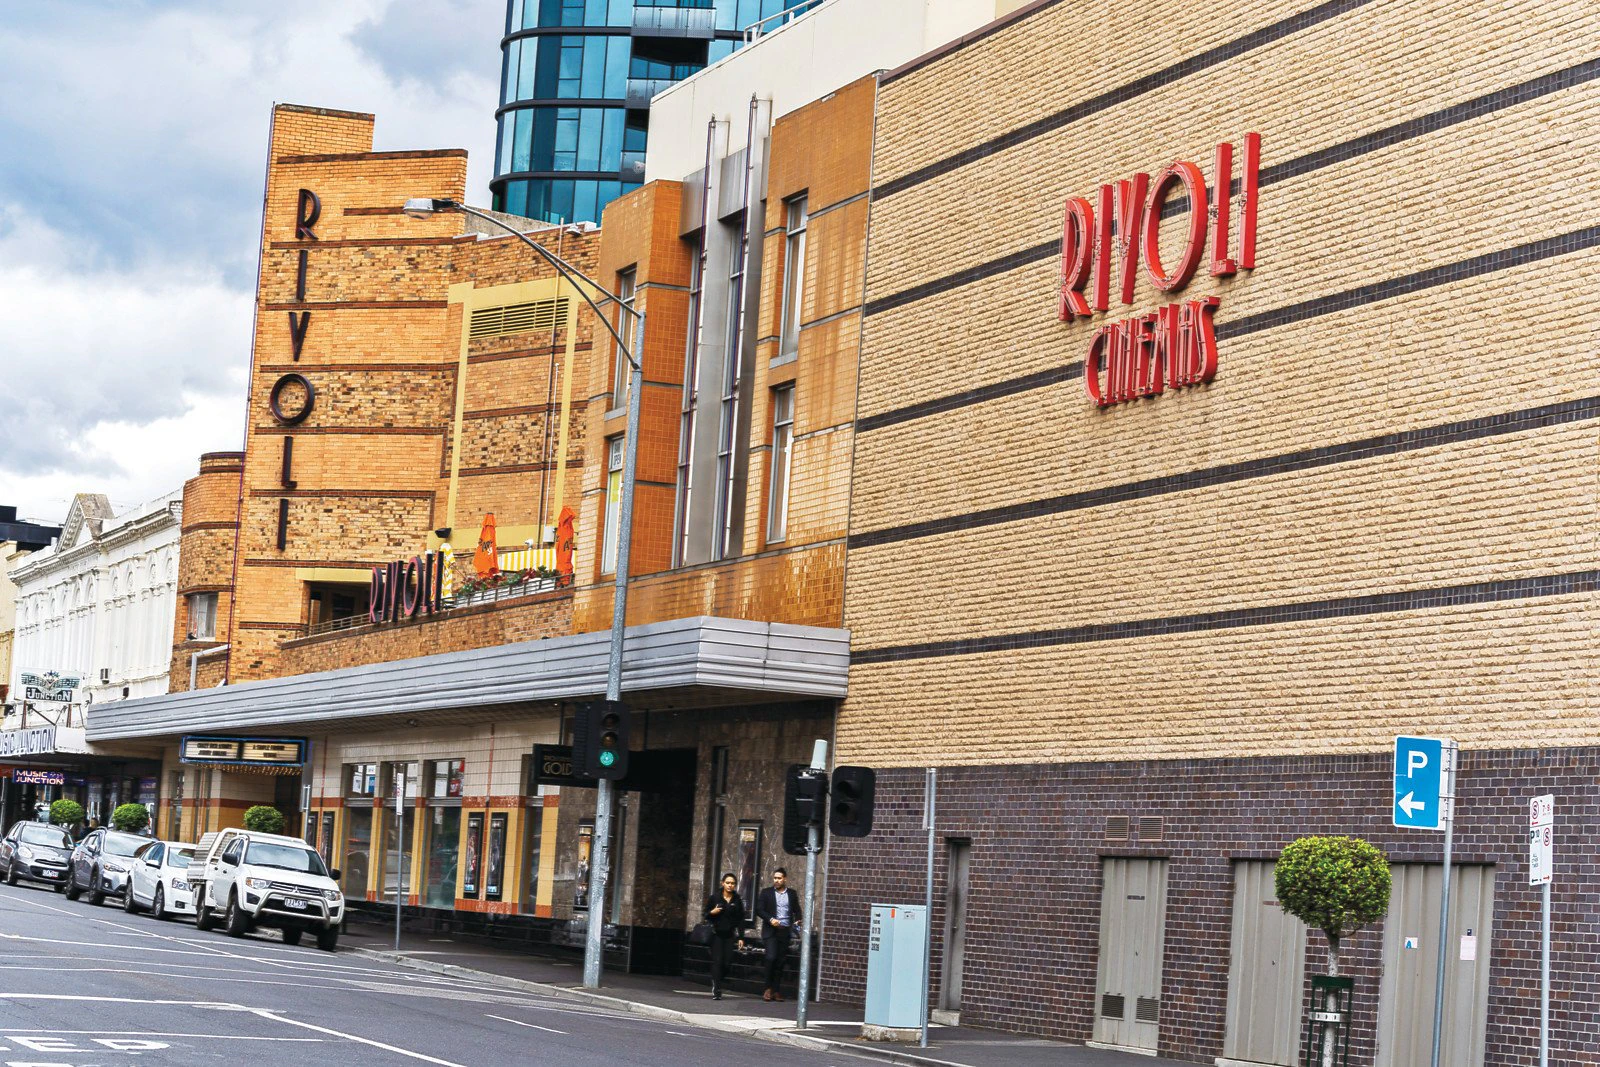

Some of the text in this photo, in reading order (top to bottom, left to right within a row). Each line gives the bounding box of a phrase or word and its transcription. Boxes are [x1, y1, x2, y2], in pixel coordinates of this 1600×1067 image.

[1059, 132, 1261, 322] RIVOLI
[269, 188, 322, 550] RIVOLI
[1083, 296, 1220, 407] CINEMAS
[369, 550, 444, 623] RIVOLI
[26, 688, 72, 702] JUNCTION
[16, 770, 48, 778] MUSIC
[16, 777, 64, 785] JUNCTION
[1407, 750, 1428, 779] P
